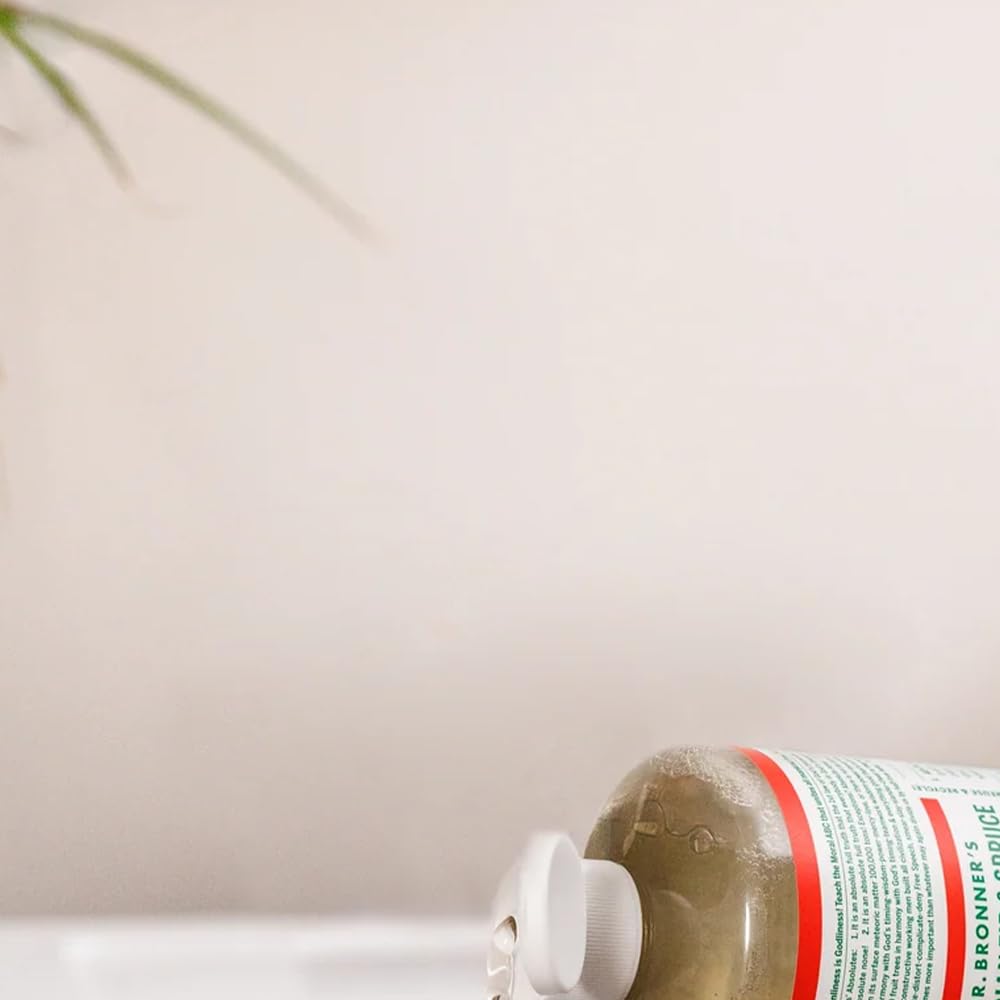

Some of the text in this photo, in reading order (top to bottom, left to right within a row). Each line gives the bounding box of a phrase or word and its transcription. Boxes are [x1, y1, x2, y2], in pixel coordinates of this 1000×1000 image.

[816, 806, 828, 820] that
[830, 804, 840, 814] the
[843, 809, 853, 822] that
[822, 822, 833, 838] ABC
[835, 816, 845, 829] that
[840, 831, 850, 849] truth
[848, 824, 859, 842] truth
[827, 840, 838, 862] Moral
[845, 852, 853, 863] full
[854, 844, 862, 856] full
[919, 845, 929, 860] may
[865, 846, 877, 878] 100,000
[830, 865, 840, 878] the
[855, 859, 867, 894] absolute
[888, 865, 898, 885] God's
[920, 862, 932, 896] whatever
[846, 866, 857, 899] absolute
[901, 876, 910, 893] built
[911, 873, 920, 889] Free
[832, 881, 843, 905] Teach
[862, 896, 868, 906] an
[869, 881, 879, 908] matter
[891, 888, 900, 904] with
[852, 902, 857, 912] an
[925, 898, 933, 917] than
[964, 841, 990, 972] BRONNER'S
[834, 908, 843, 956] Godliness!
[862, 927, 869, 935] 2.
[872, 911, 880, 948] meteoric
[893, 908, 903, 943] harmony
[904, 916, 914, 948] working
[882, 927, 890, 950] God's
[925, 919, 935, 960] important
[859, 945, 868, 969] none!
[893, 945, 901, 953] in
[833, 958, 842, 966] is
[869, 950, 879, 981] surface
[880, 953, 889, 970] with
[891, 955, 900, 976] trees
[845, 949, 857, 993] Absolutes:
[924, 962, 932, 984] more
[867, 984, 875, 993] its
[888, 979, 898, 996] fruit
